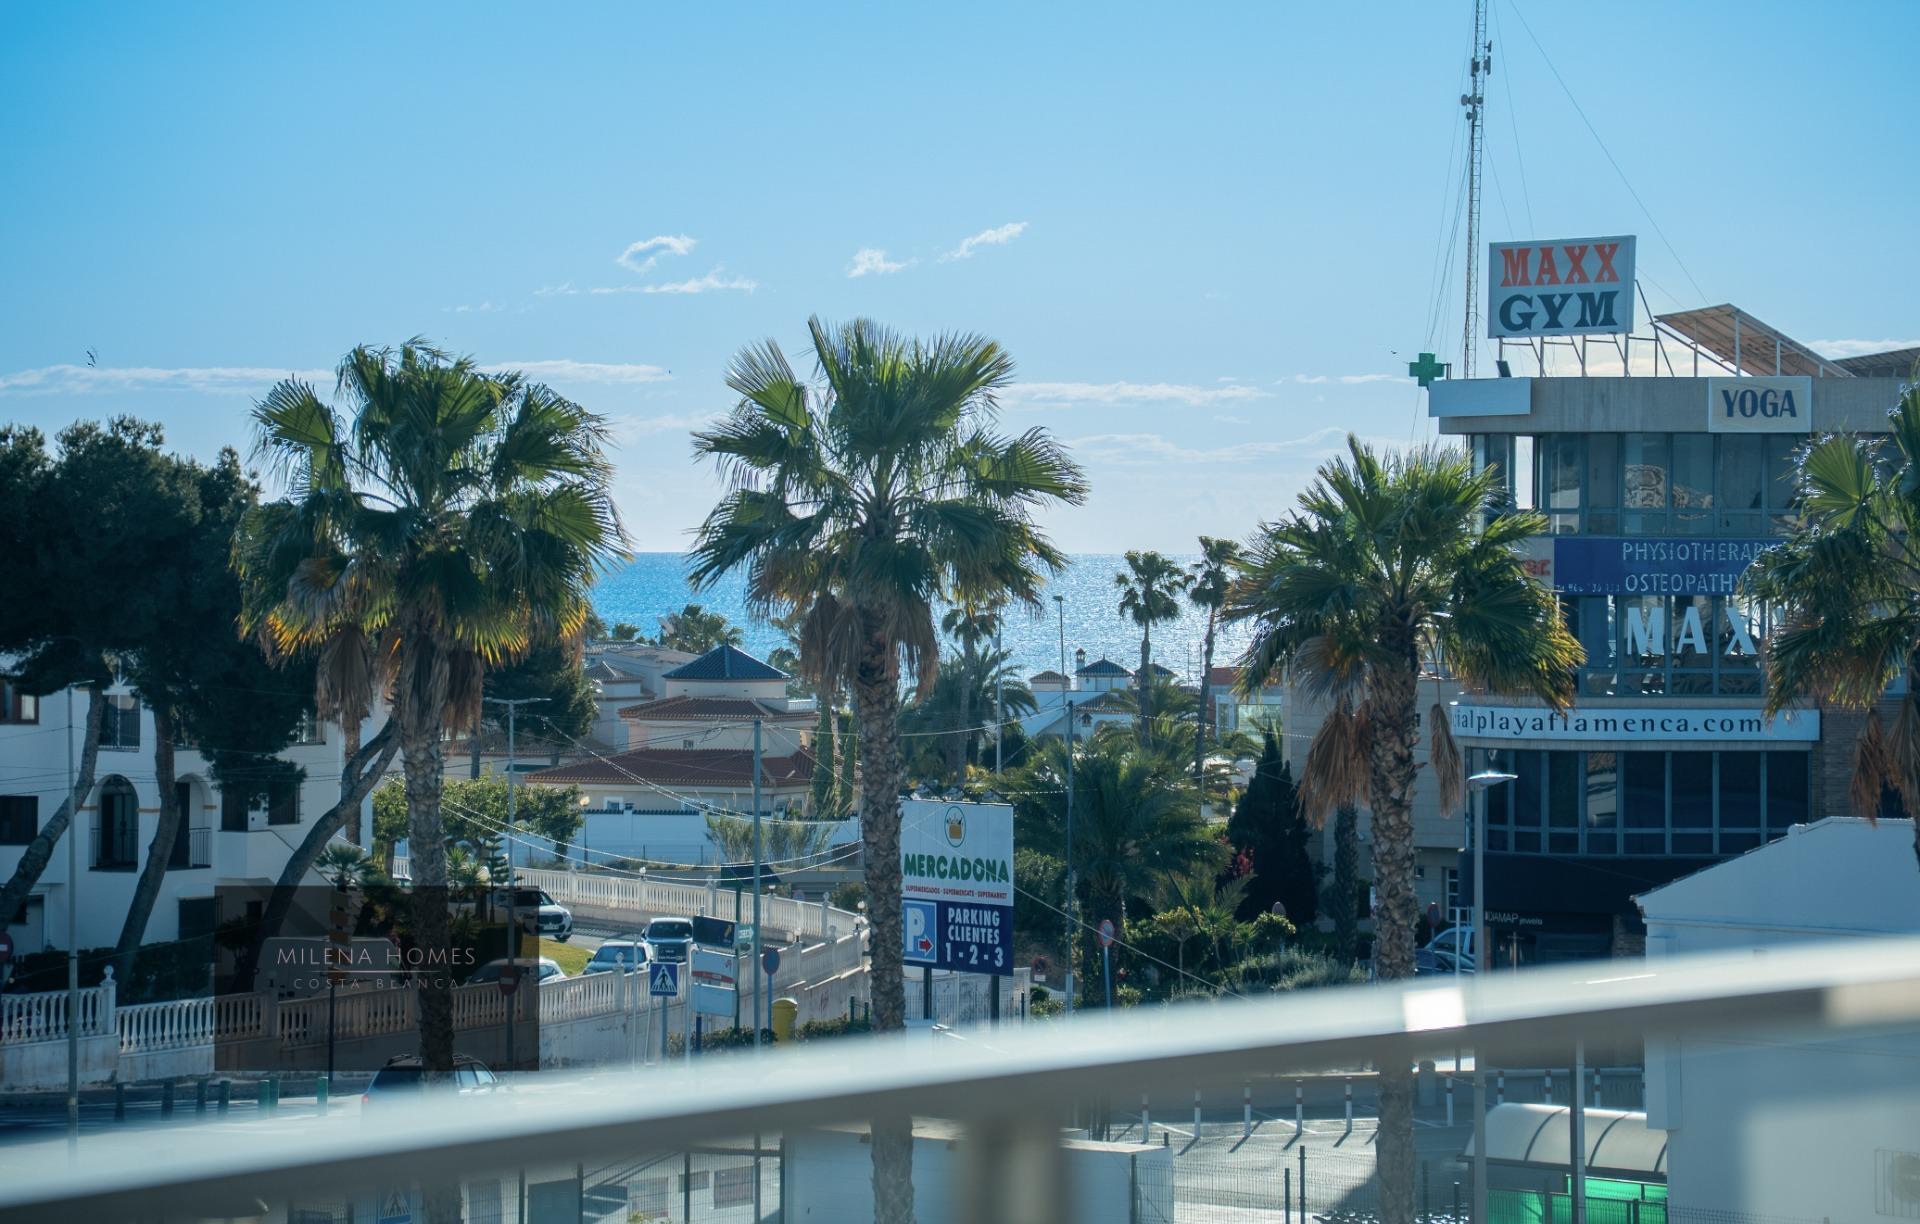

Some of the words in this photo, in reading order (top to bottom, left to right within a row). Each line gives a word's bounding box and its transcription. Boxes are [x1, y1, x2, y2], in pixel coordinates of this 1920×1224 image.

[1500, 243, 1620, 287] MAXX
[1499, 291, 1620, 331] GYM
[1721, 389, 1797, 418] YOGA
[1627, 606, 1785, 655] MAX
[904, 853, 1010, 883] MERCADONA
[906, 907, 925, 952] P
[948, 907, 1000, 926] PARKING
[948, 925, 1000, 945] CLIENTES
